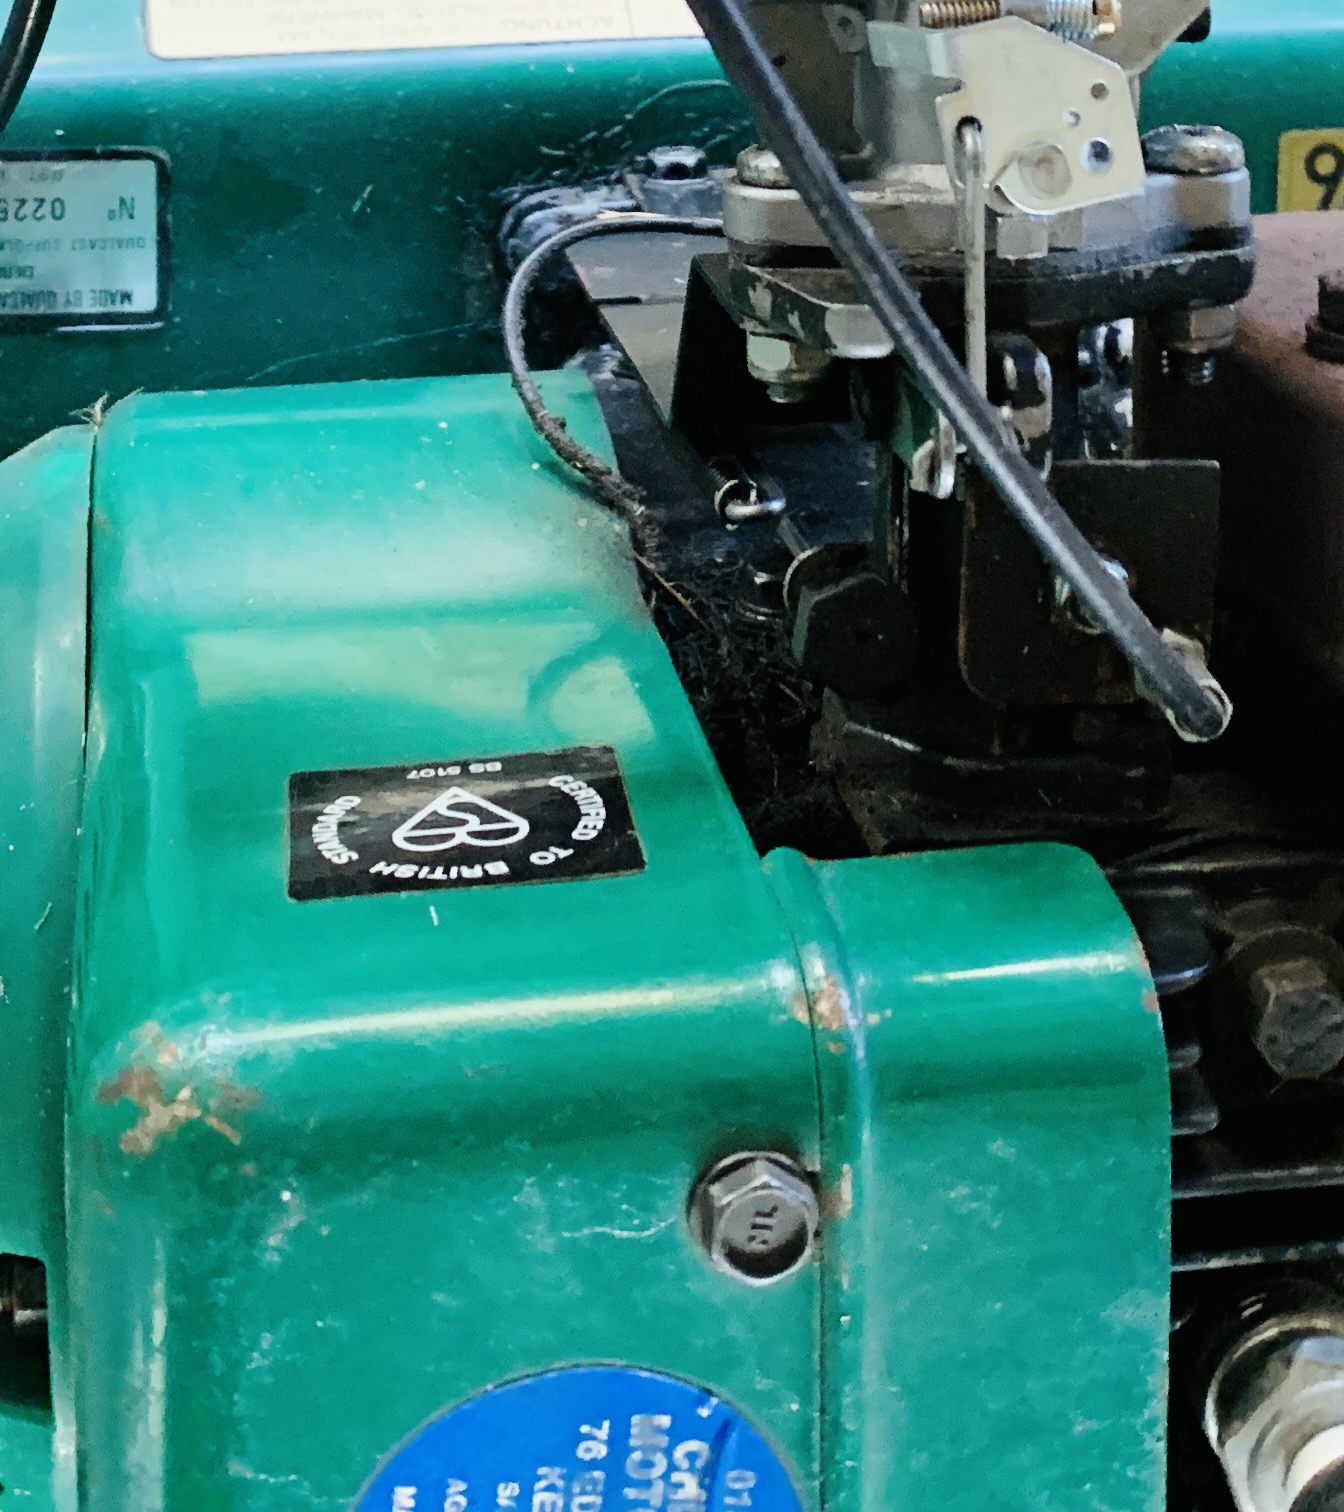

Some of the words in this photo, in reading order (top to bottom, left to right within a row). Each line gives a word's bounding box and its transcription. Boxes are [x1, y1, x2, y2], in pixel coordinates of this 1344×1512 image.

[62, 290, 83, 307] BY
[89, 289, 133, 306] MADE
[547, 774, 607, 842] CERTIFIED
[310, 794, 359, 866] STANDARD
[368, 860, 510, 881] BRITISH
[529, 845, 574, 867] TO
[575, 1418, 611, 1462] 76
[623, 1414, 672, 1512] MOT
